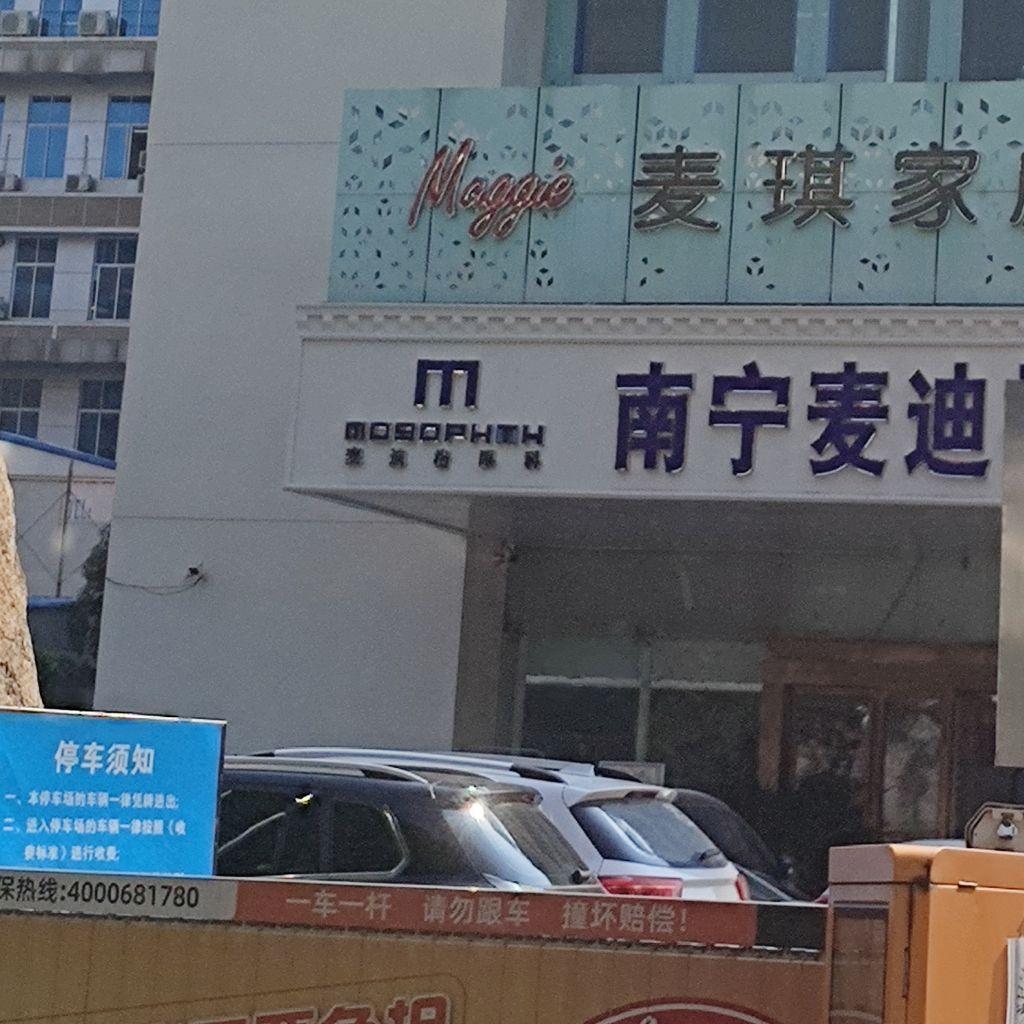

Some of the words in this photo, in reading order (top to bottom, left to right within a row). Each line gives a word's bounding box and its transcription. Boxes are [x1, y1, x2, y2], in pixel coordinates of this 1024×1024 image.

[407, 137, 574, 241] Maggie
[54, 740, 156, 775] 停车须知
[286, 889, 392, 921] 一车一杆
[422, 892, 530, 929] 请勿跟车
